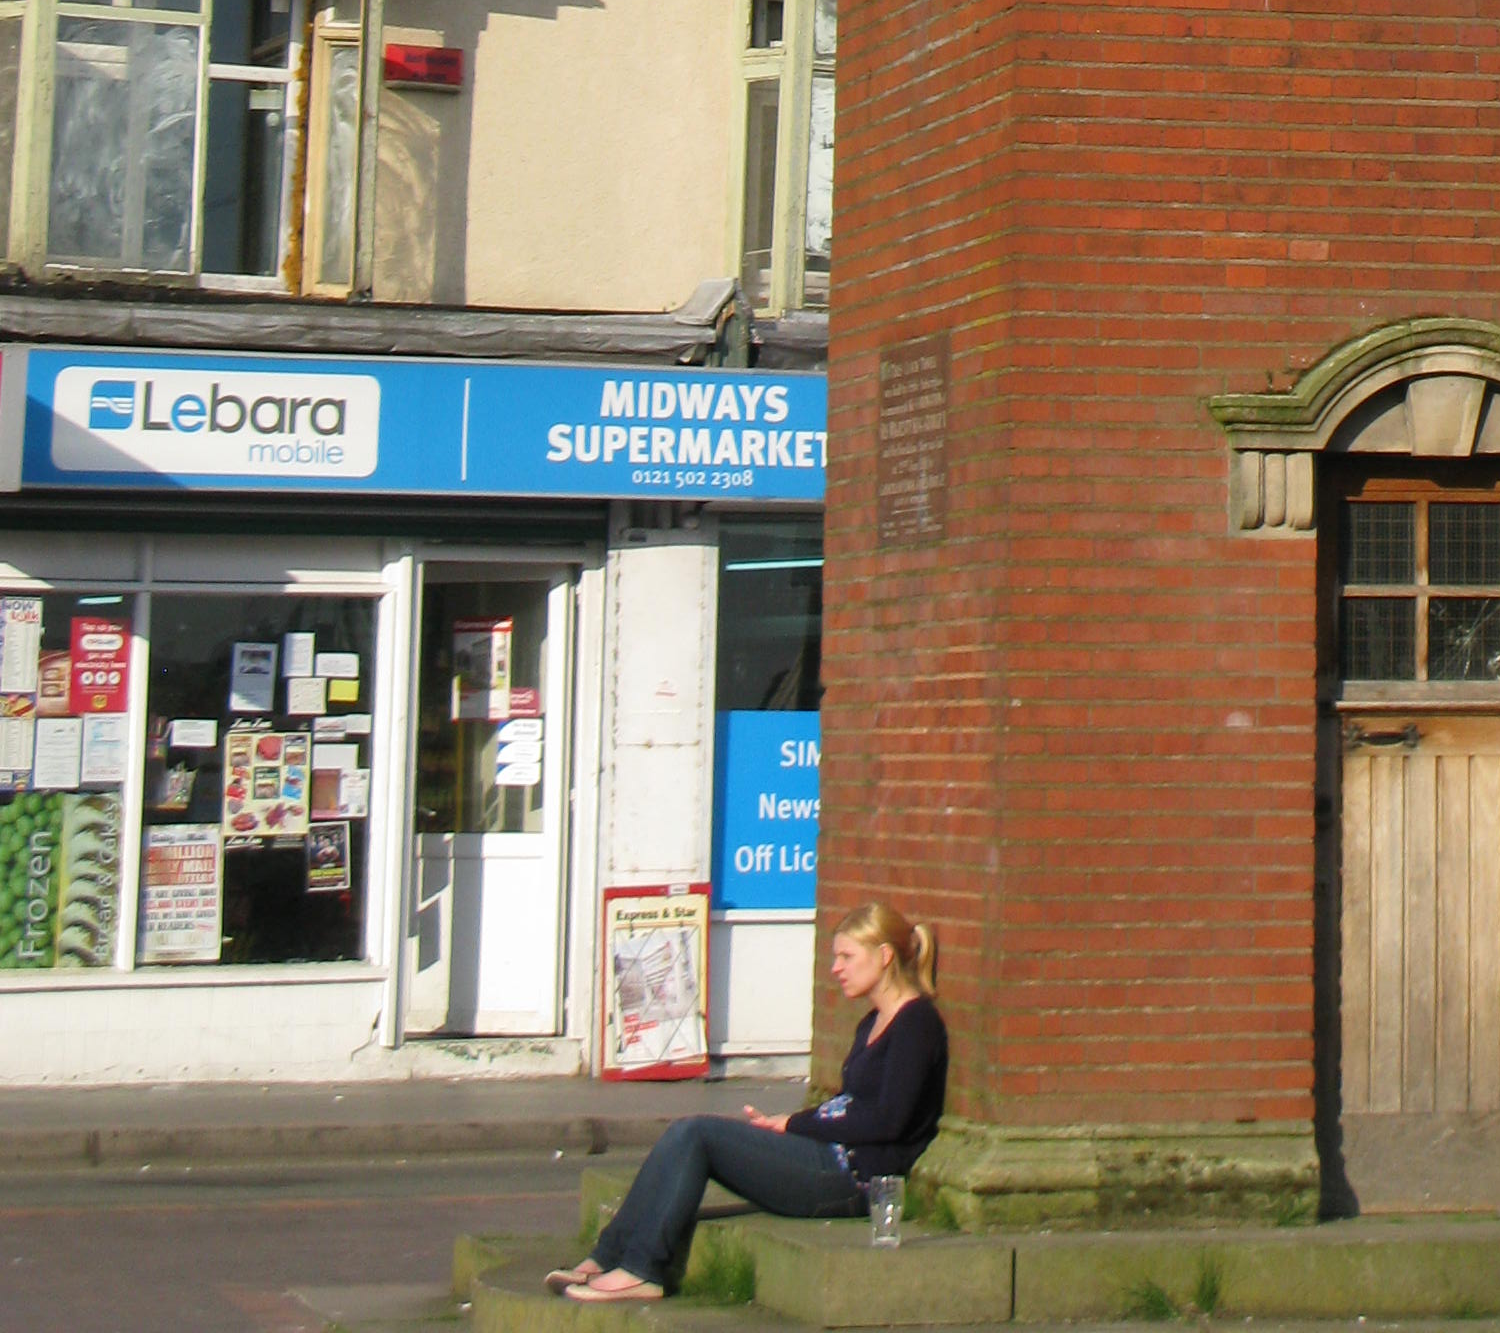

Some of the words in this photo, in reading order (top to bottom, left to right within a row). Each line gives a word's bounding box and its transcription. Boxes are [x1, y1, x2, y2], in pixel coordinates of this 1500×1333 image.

[142, 381, 347, 436] Lebara
[600, 380, 789, 423] MIDWAYS
[248, 439, 344, 465] mobile
[632, 469, 671, 484] 0121
[675, 471, 706, 489] 502
[711, 469, 753, 490] 2308
[735, 844, 774, 872] Off
[779, 844, 818, 872] Lic
[17, 831, 52, 961] Frozen
[616, 909, 658, 921] Express
[662, 907, 670, 918] &
[674, 906, 698, 918] Star
